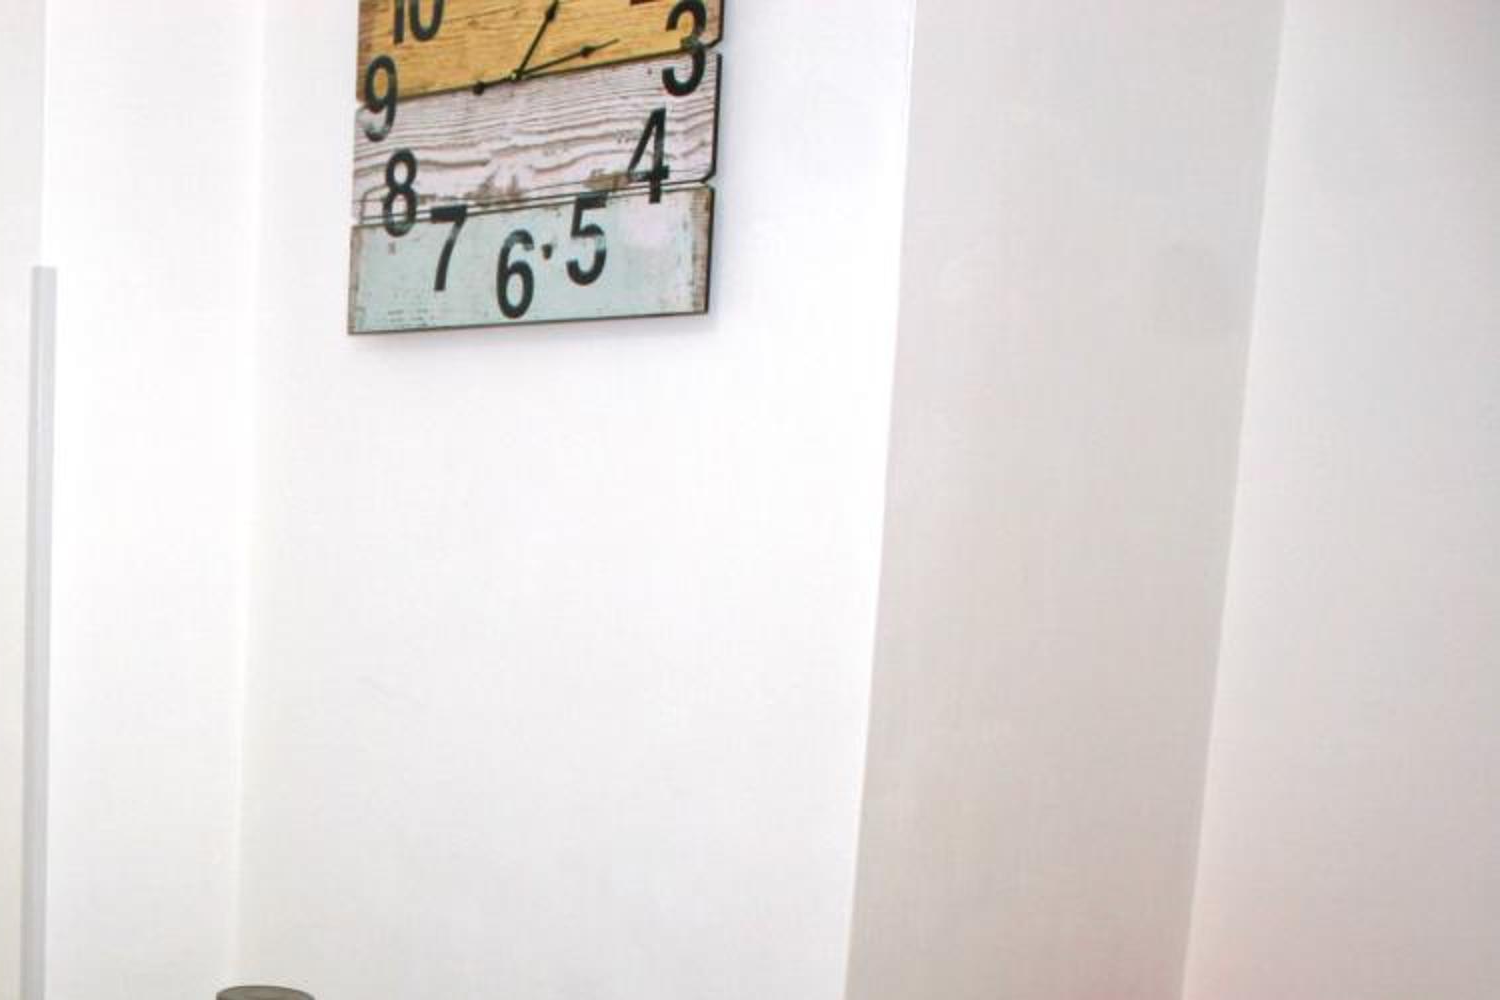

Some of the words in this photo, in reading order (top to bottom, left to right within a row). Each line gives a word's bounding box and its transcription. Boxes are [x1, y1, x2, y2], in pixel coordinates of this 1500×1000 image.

[661, 0, 708, 97] 3
[363, 55, 399, 142] 9
[382, 147, 418, 238] 8
[627, 107, 670, 204] 4
[430, 204, 468, 292] 7
[495, 229, 535, 319] 6
[566, 190, 609, 287] 5
